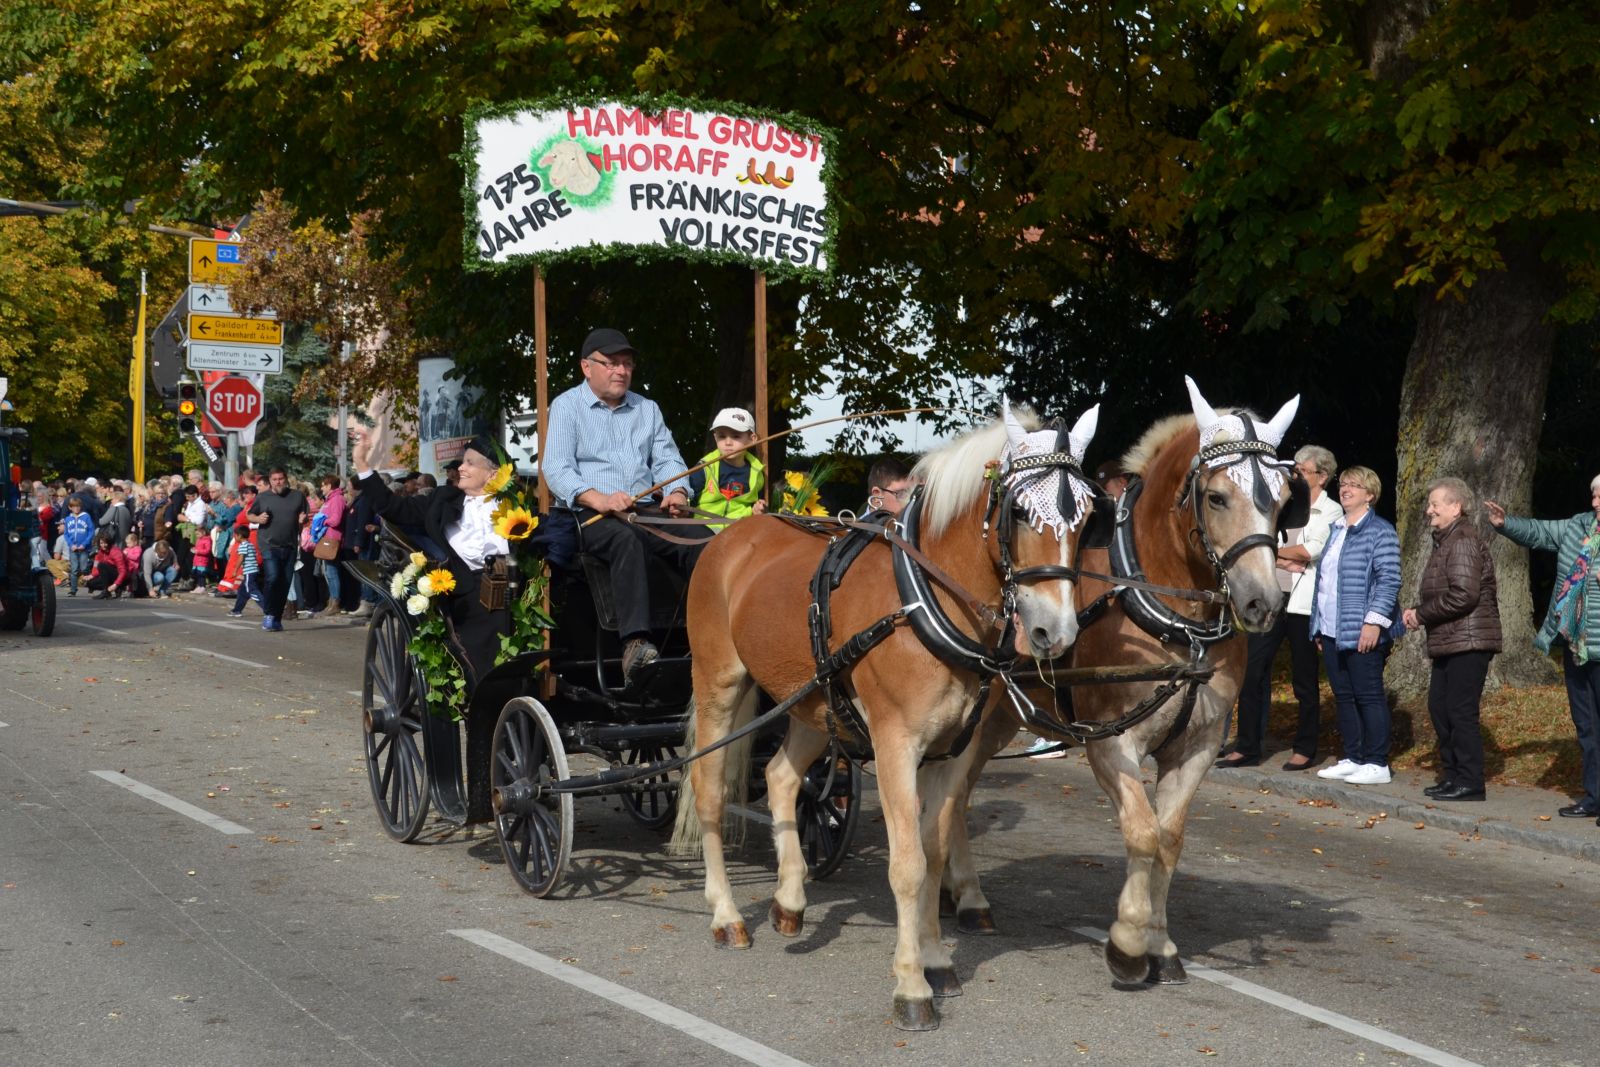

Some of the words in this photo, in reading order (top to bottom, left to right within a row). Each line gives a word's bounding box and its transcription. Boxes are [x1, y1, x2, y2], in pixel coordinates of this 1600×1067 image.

[567, 108, 699, 140] HAMMEL
[603, 143, 729, 177] HORAFF
[484, 163, 541, 211] 175
[481, 189, 572, 258] JAHRE
[629, 180, 827, 237] FRÄNKISCHES
[659, 217, 822, 267] VOLKSFEST
[215, 320, 249, 330] Gaildorf
[215, 329, 256, 340] Frankenhardt
[193, 356, 240, 366] Altenmünster
[211, 349, 240, 358] Zentrum
[213, 392, 257, 414] STOP
